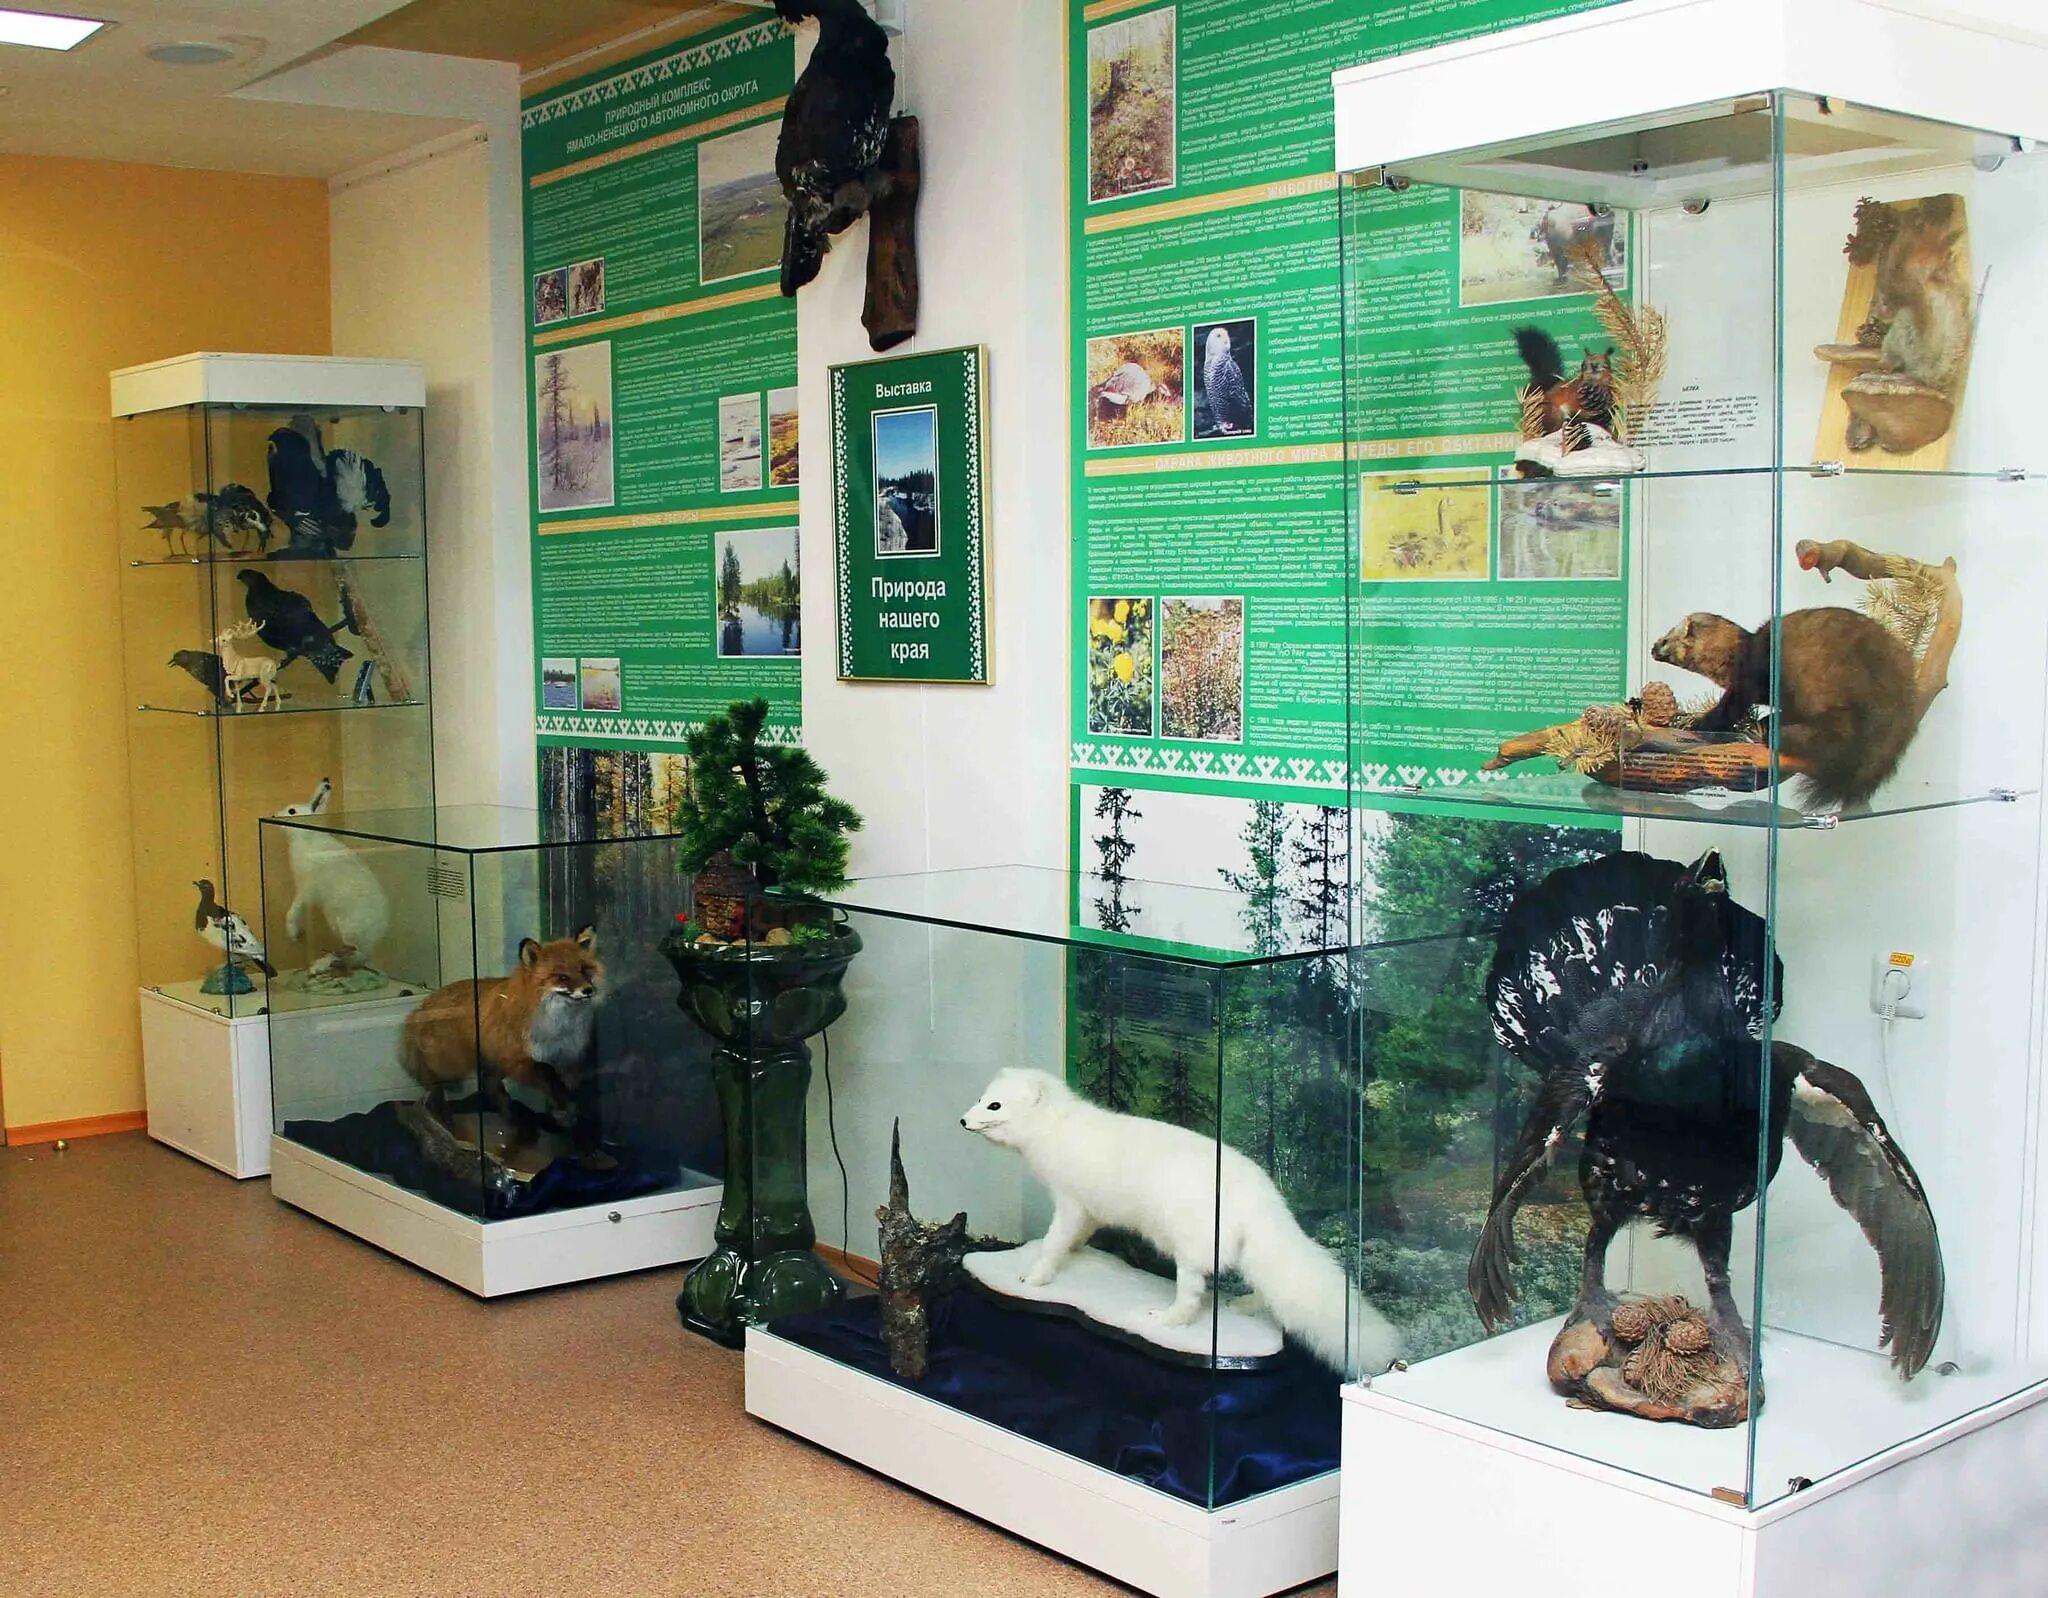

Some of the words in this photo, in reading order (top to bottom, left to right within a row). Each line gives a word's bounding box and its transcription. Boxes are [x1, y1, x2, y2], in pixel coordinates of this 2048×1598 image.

[605, 94, 660, 125] ПРИРОДНЫЙ
[661, 77, 711, 104] КОМПЛЕКС
[566, 116, 648, 154] ЯМАЛО-НЕНЕЦКОГО
[649, 92, 719, 126] АВТОНОМНОГО
[721, 79, 759, 103] ОКРУГА
[1268, 174, 1341, 198] ЖИВОТНЫ
[875, 379, 932, 398] Выставка
[1208, 450, 1284, 467] ЖИВОТНОГО
[1293, 447, 1327, 460] МИРА
[1407, 440, 1434, 455] ЕГО
[872, 576, 946, 602] Природа
[879, 610, 940, 629] нашего
[891, 641, 929, 663] края
